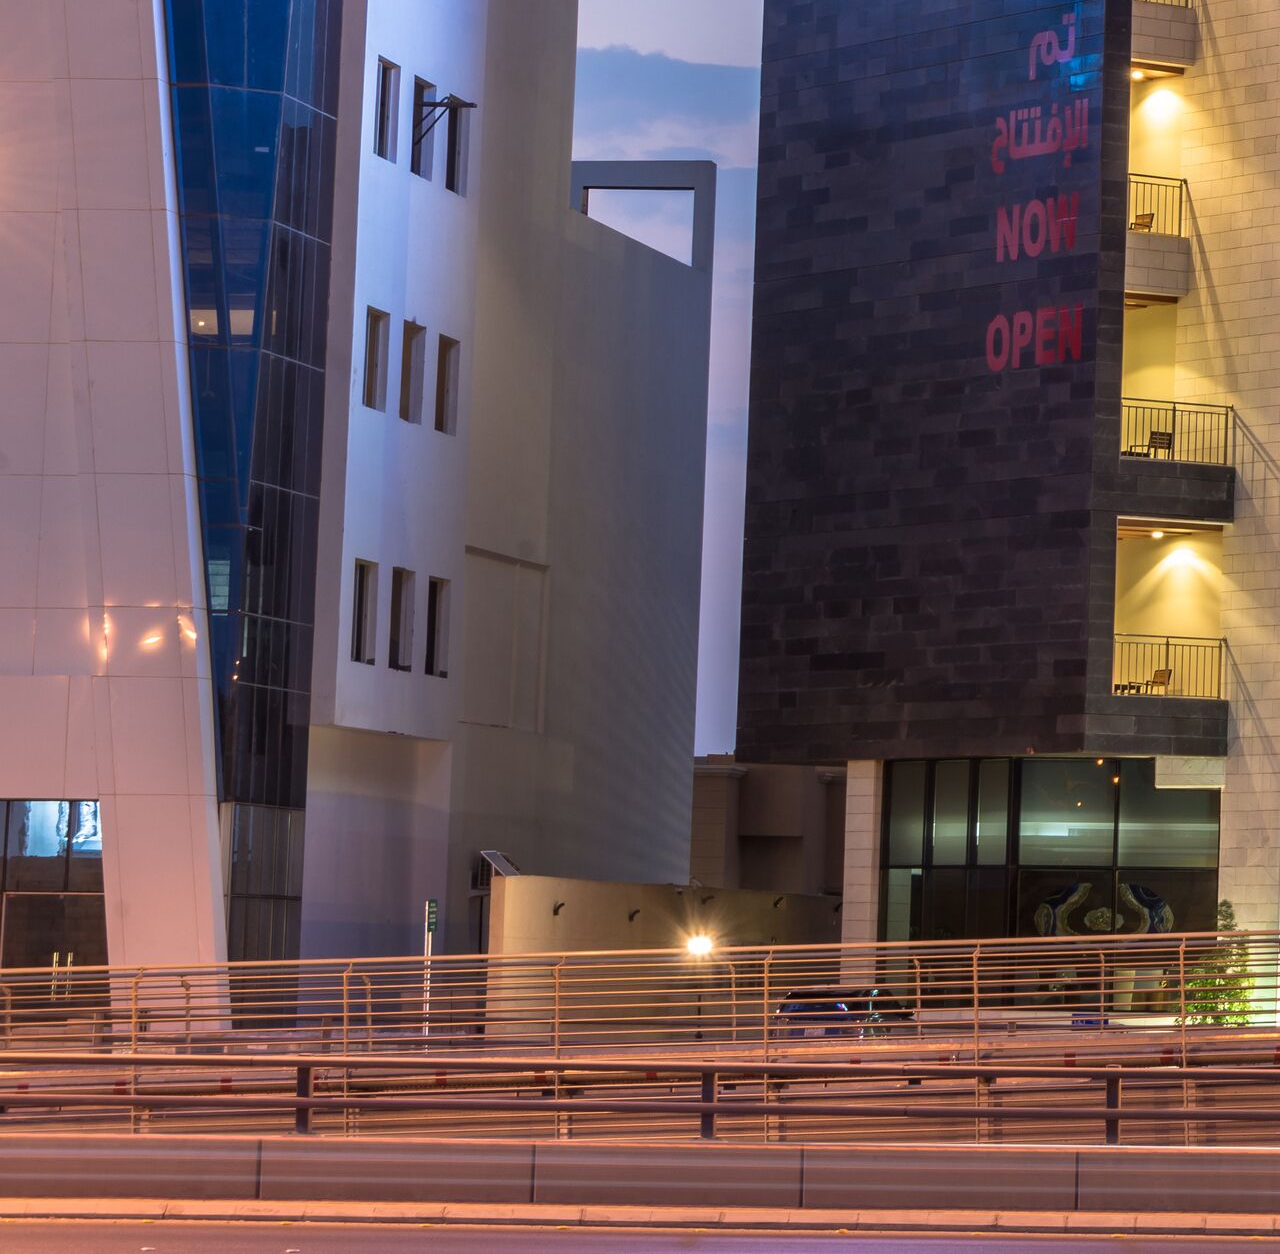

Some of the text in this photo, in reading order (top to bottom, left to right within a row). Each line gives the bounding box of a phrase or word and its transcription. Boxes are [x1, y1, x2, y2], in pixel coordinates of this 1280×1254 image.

[1028, 13, 1076, 80] تم
[996, 190, 1080, 263] NOW
[986, 302, 1083, 372] OPEN
